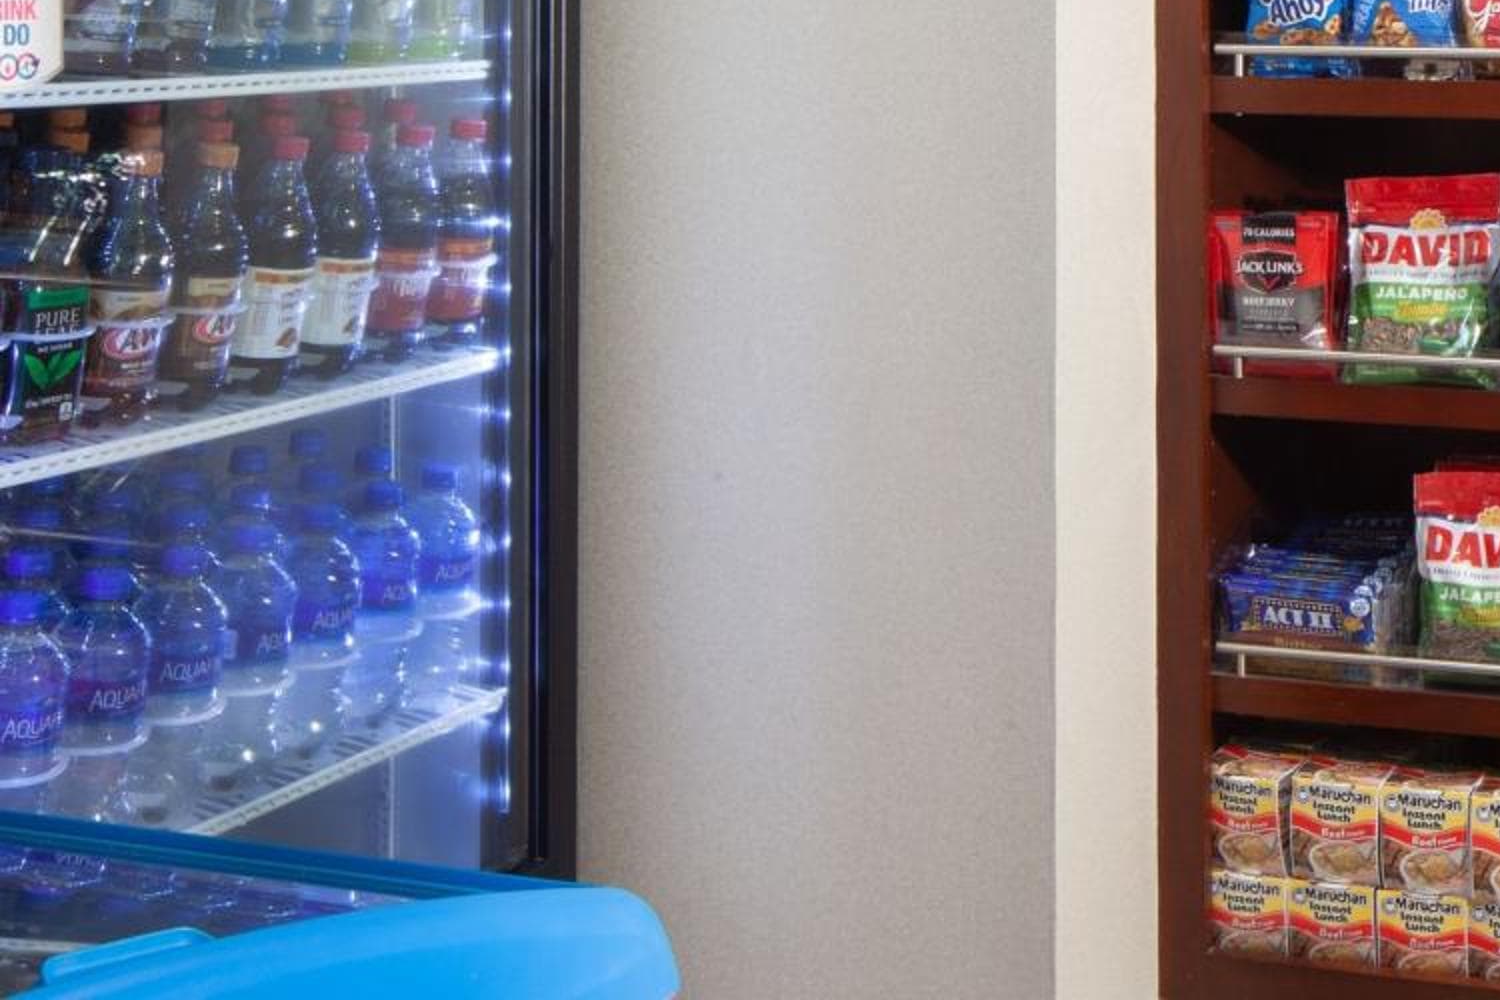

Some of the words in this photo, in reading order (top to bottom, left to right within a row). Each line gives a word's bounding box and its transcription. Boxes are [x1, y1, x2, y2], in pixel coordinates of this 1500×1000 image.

[4, 24, 30, 46] DO
[1361, 230, 1490, 266] DAVID
[1236, 260, 1265, 273] JACK
[35, 308, 80, 329] PURE
[1264, 605, 1304, 628] ACT
[1309, 785, 1371, 805] Maruchan
[1398, 793, 1462, 811] Maruchan
[1219, 877, 1280, 896] Maruchan
[1305, 887, 1367, 905] Maruchan
[1396, 898, 1460, 915] Maruchan
